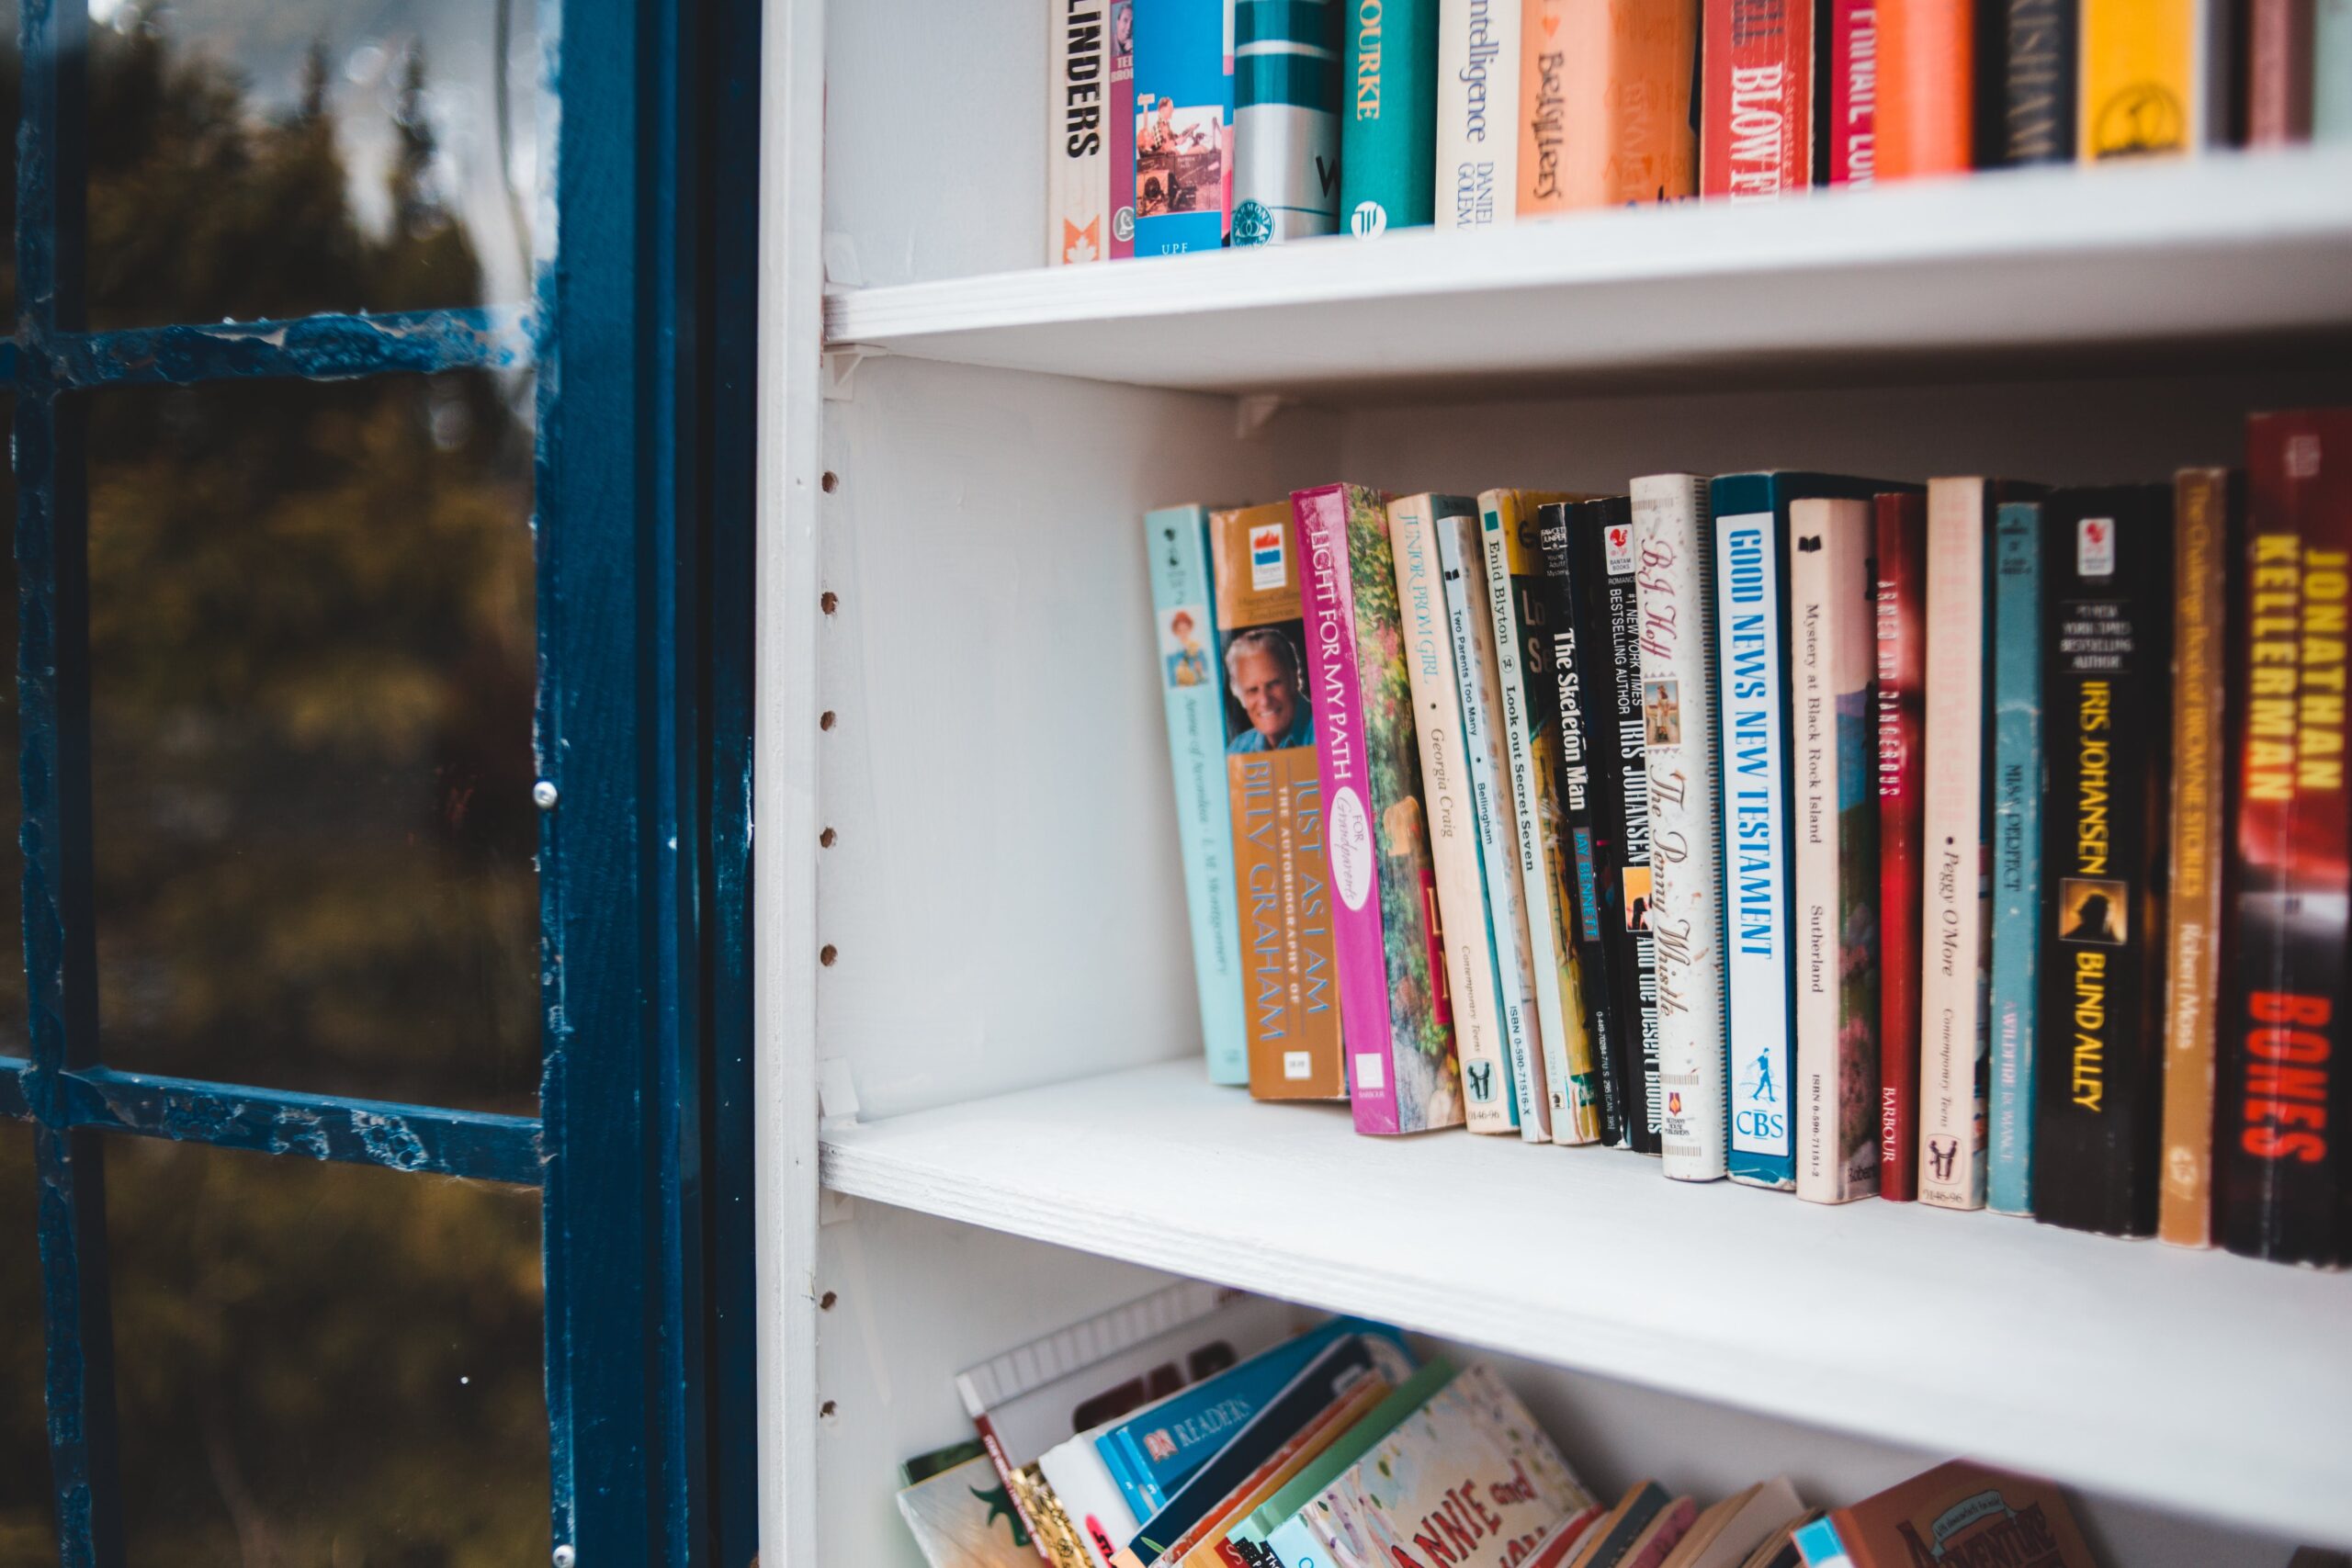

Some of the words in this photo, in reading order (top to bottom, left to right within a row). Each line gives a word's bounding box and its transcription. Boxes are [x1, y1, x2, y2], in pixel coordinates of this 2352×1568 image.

[1311, 530, 1338, 604] LIGHT
[1397, 512, 1426, 592] JUNIOR
[1488, 539, 1504, 581] Enid
[1728, 528, 1764, 604] GOOD
[1318, 609, 1340, 660] FOR
[1412, 585, 1433, 637] PROM
[1453, 608, 1463, 634] Two
[1494, 582, 1510, 646] Blyton
[1610, 588, 1628, 666] BESTSELLING
[1626, 607, 1639, 637] NEW
[1639, 602, 1678, 660] Hoff
[1805, 604, 1823, 670] Mystery
[1876, 581, 1898, 640] ARMED
[1416, 638, 1439, 684] GIRL
[1458, 636, 1470, 679] Parents
[1554, 627, 1575, 671] The
[1628, 634, 1641, 669] YORK
[1731, 613, 1767, 700] NEWS
[1877, 651, 1897, 681] AND
[2246, 536, 2300, 800] KELLERMAN
[2299, 549, 2348, 789] JONATHAN
[1324, 663, 1348, 710] MY
[1464, 682, 1473, 704] Too
[1505, 684, 1520, 727] Look
[1614, 667, 1631, 715] AUTHOR
[1631, 671, 1643, 706] TIMES
[1806, 674, 1818, 692] at
[2080, 681, 2110, 732] IRIS
[1467, 706, 1478, 736] Many
[1557, 671, 1588, 762] Skeleton
[1619, 719, 1645, 761] IRIS
[1806, 697, 1822, 742] Black
[1878, 690, 1901, 796] DANGEROUS
[1329, 714, 1351, 781] PATH
[1430, 728, 1448, 792] Georgia
[1510, 731, 1522, 761] out
[1735, 711, 1769, 778] NEW
[1808, 748, 1823, 790] Rock
[1243, 761, 1274, 851] BILLY
[1278, 785, 1288, 818] THE
[1476, 782, 1493, 845] Bellingham
[1514, 762, 1530, 816] Secret
[1566, 765, 1589, 811] Man
[1622, 764, 1650, 863] JOHANSEN
[1650, 764, 1686, 818] The
[2077, 735, 2110, 875] JOHANSEN
[1352, 815, 1364, 842] FOR
[1440, 794, 1454, 838] Craig
[1808, 795, 1822, 844] Island
[1521, 818, 1534, 872] Seven
[1574, 830, 1590, 857] JAY
[2005, 812, 2023, 893] PERFECT
[1301, 874, 1325, 920] AS
[1578, 860, 1600, 937] BENNETT
[1654, 829, 1688, 919] Penny
[1737, 785, 1772, 960] TESTAMENT
[1939, 851, 1960, 904] Peggy
[1281, 828, 1299, 975] AUTOBIOGRAPHY
[1249, 863, 1285, 1042] GRAHAM
[1306, 928, 1325, 936] I
[1810, 905, 1825, 993] Sutherland
[1941, 908, 1960, 977] O'More
[2177, 923, 2202, 988] Robert
[1290, 983, 1300, 1006] OF
[1306, 950, 1329, 1014] AM
[1462, 945, 1476, 1021] Contemporary
[1657, 919, 1691, 1017] Whistle
[2074, 951, 2107, 1030] BLIND
[1472, 1021, 1481, 1054] Teens
[1510, 1005, 1521, 1034] ISBN
[2177, 991, 2200, 1051] Moss
[1941, 1008, 1954, 1091] Contemporary
[2002, 1012, 2017, 1090] WILDFIRE
[2072, 1032, 2105, 1113] ALLEY
[2240, 989, 2333, 1164] BONES
[1811, 1073, 1820, 1102] ISBN
[1940, 1096, 1952, 1129] Teens
[1736, 1110, 1784, 1140] CBS
[1883, 1087, 1897, 1163] BARBOUR
[1173, 1396, 1252, 1448] READERS
